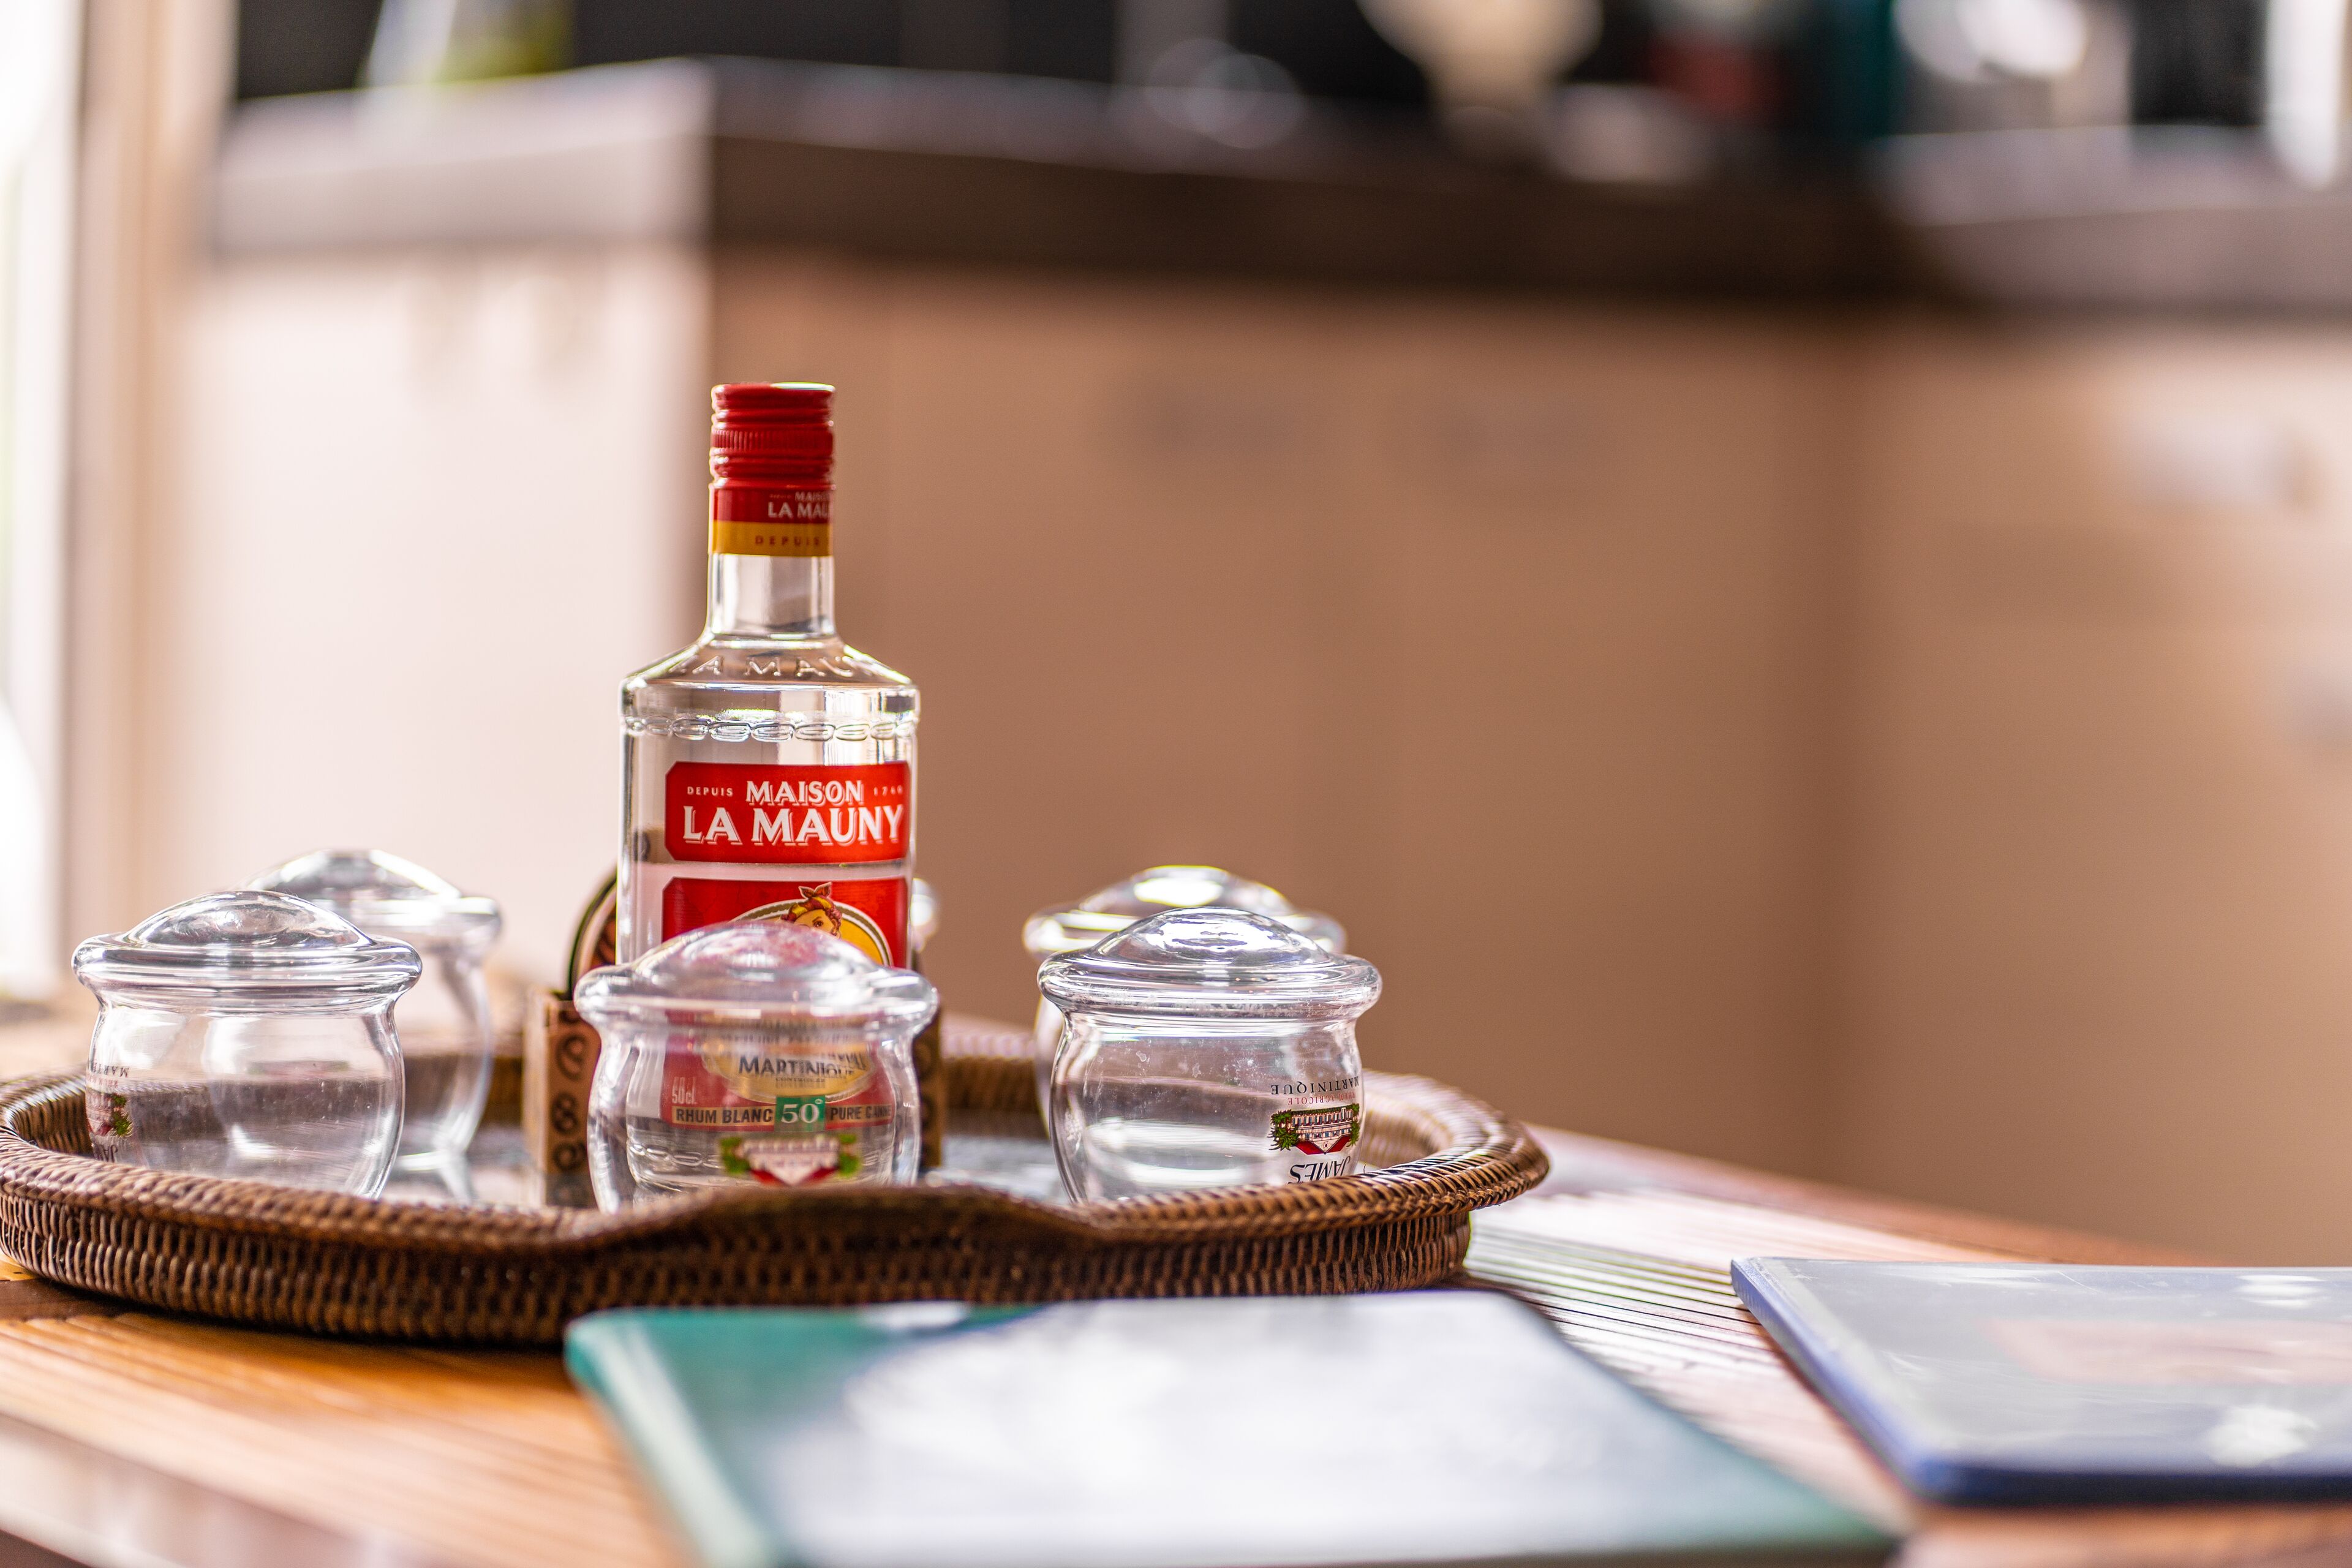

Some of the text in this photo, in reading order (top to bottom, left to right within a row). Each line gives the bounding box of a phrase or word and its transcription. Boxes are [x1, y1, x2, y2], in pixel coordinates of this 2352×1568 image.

[767, 502, 794, 518] LA
[755, 535, 820, 546] DEPUIS
[687, 786, 733, 796] DEPUIS
[746, 780, 864, 805] MAISON
[683, 804, 903, 846] LA MAUNY
[1270, 1076, 1359, 1095] MARTINIQUE
[1287, 1094, 1334, 1106] AGRICOLE
[676, 1108, 717, 1123] RHUM
[722, 1108, 773, 1123] BLANC
[831, 1106, 862, 1120] PURE
[1287, 1156, 1351, 1185] JAMES
